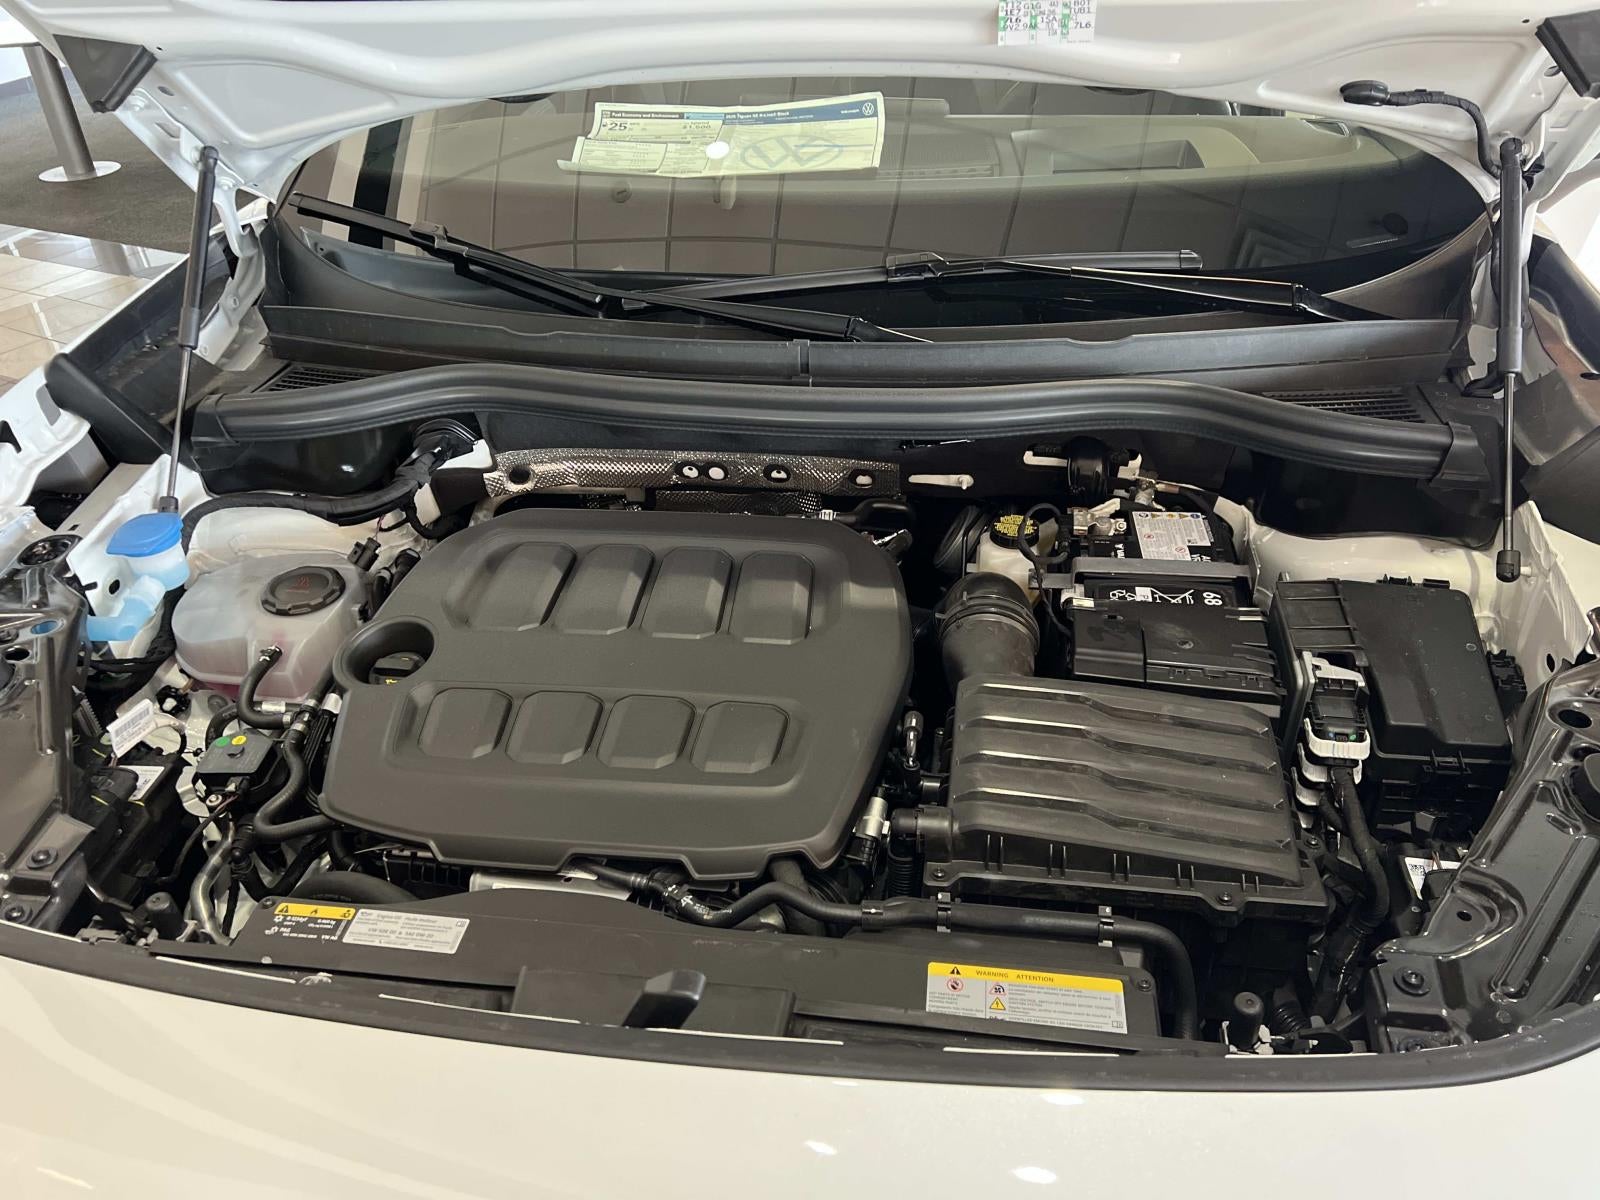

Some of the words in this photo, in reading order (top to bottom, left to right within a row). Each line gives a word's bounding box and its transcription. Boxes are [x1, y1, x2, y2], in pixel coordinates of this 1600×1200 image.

[608, 122, 628, 131] 25
[975, 969, 1009, 979] WARNING
[1016, 974, 1054, 983] ATTENTION
